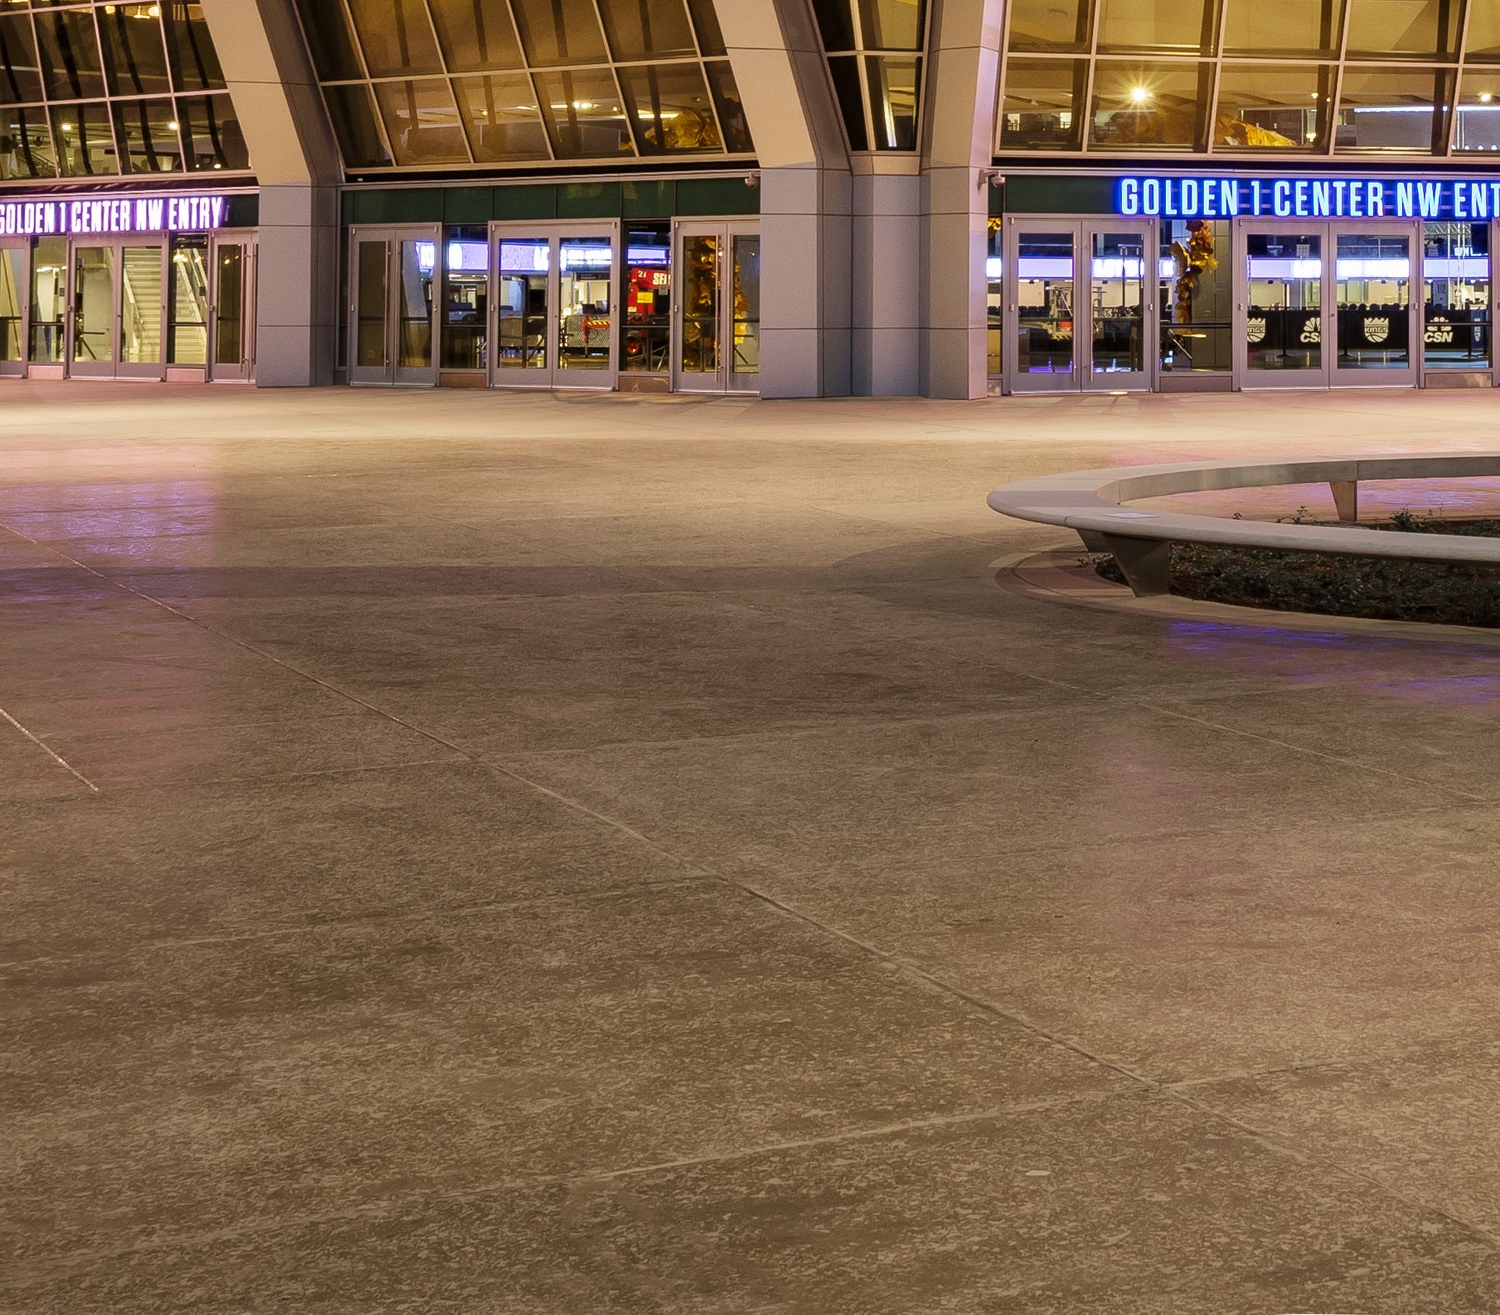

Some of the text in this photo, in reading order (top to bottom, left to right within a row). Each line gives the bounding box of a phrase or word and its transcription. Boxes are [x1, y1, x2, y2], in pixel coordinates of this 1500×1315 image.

[59, 202, 66, 233] 1
[71, 200, 131, 233] CENTER
[136, 199, 163, 231] NW
[169, 197, 222, 230] ENTRY
[1121, 179, 1238, 216] GOLDEN
[1250, 180, 1260, 216] 1
[1274, 180, 1384, 216] CENTER
[1397, 182, 1441, 217] NW
[1424, 331, 1454, 343] CSN
